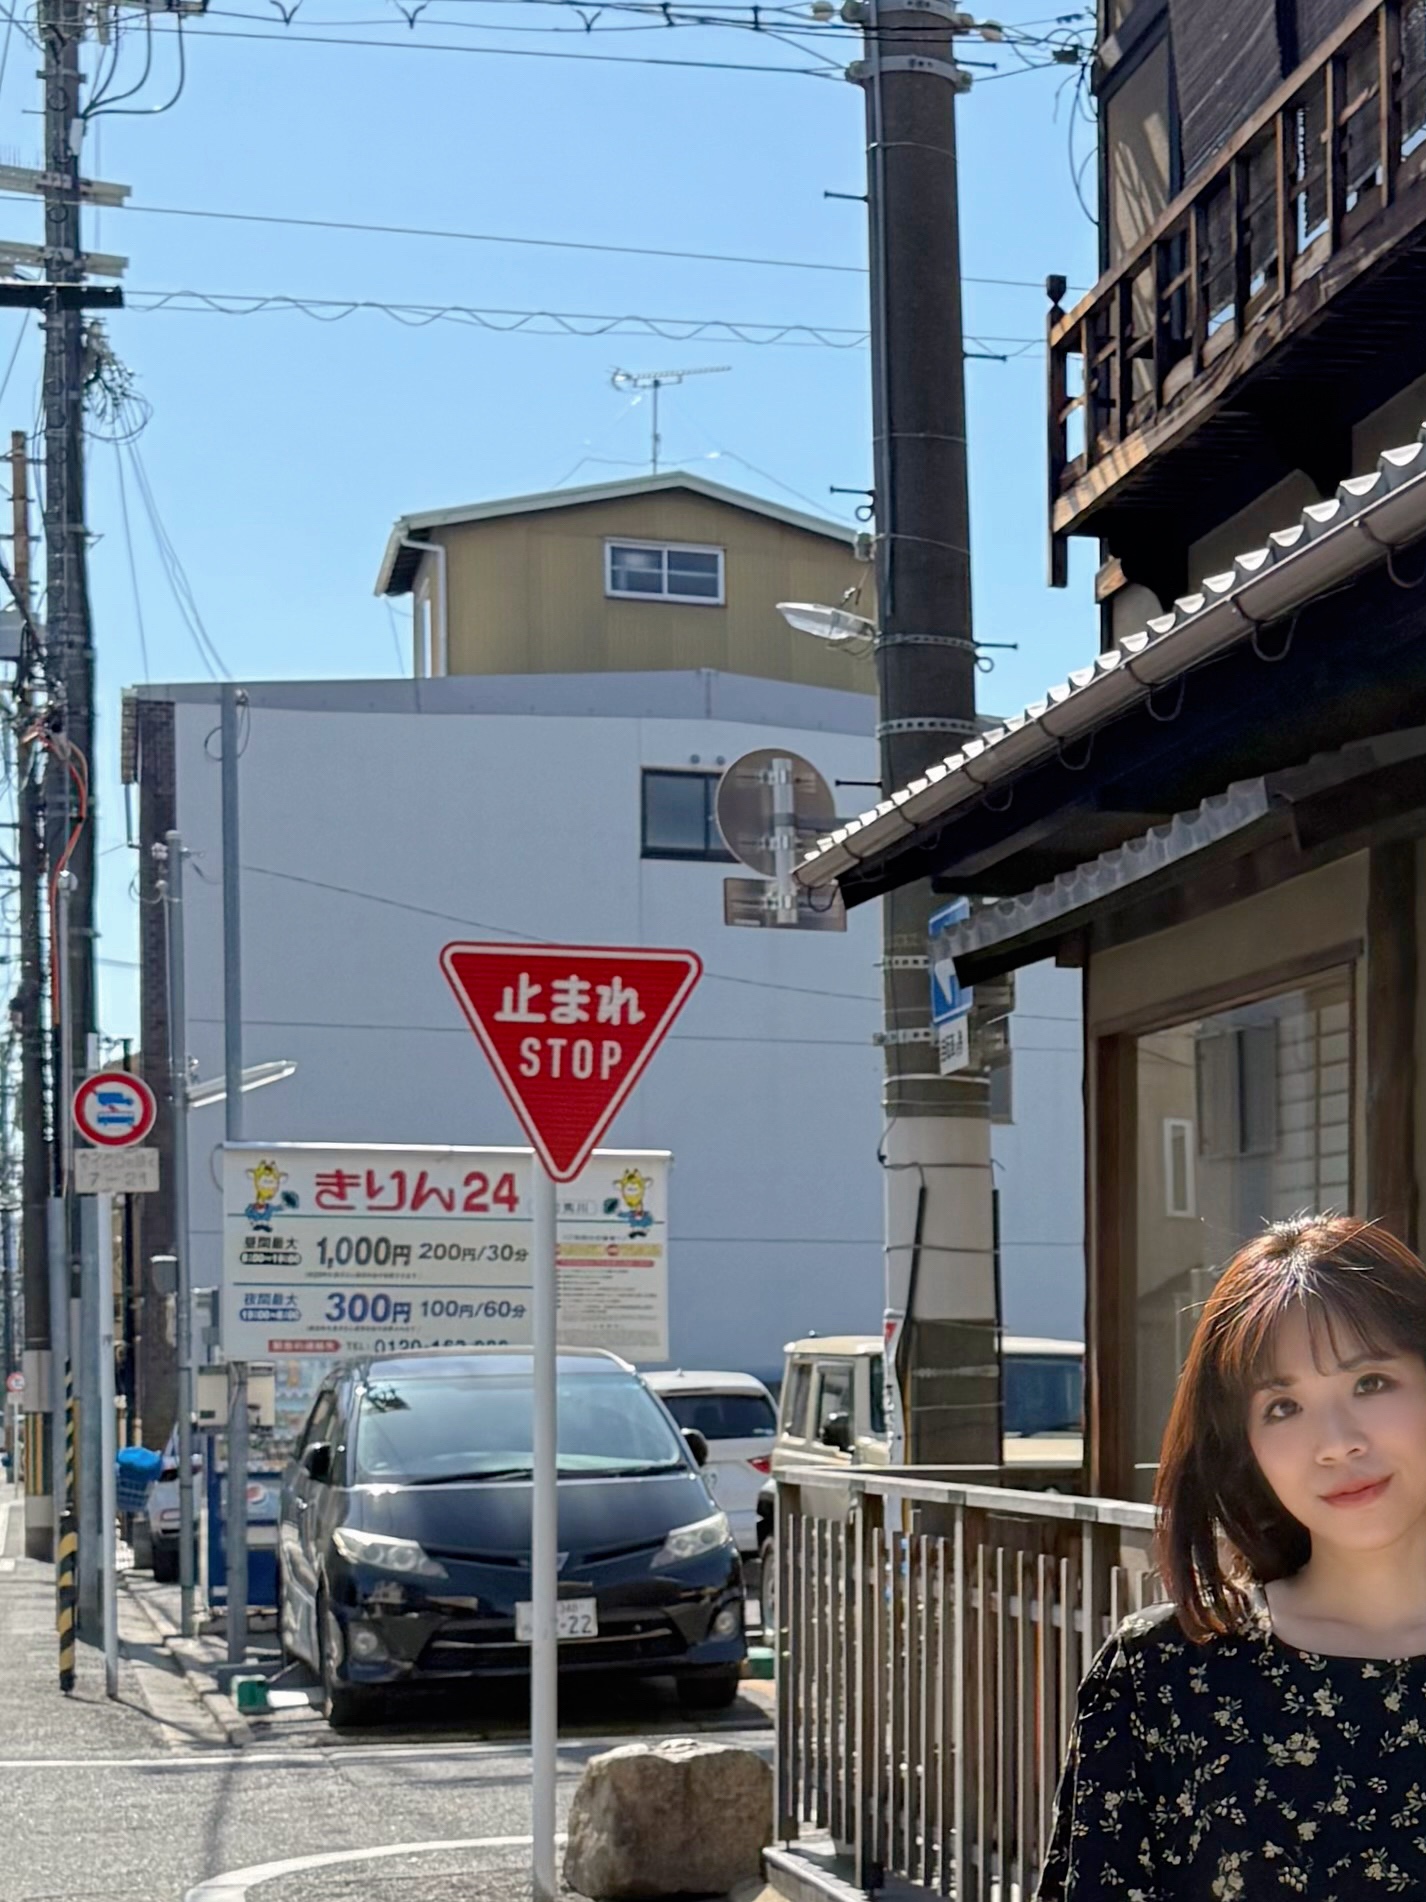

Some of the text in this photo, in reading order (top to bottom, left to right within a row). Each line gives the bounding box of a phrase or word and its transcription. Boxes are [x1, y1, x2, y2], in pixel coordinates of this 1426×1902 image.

[493, 972, 646, 1026] 止まれ
[519, 1037, 622, 1080] STOP
[315, 1169, 519, 1213] きりん24
[316, 1236, 411, 1268] 1,000円
[418, 1242, 529, 1262] 200円/30分
[325, 1292, 527, 1324] 300円 100円/60分
